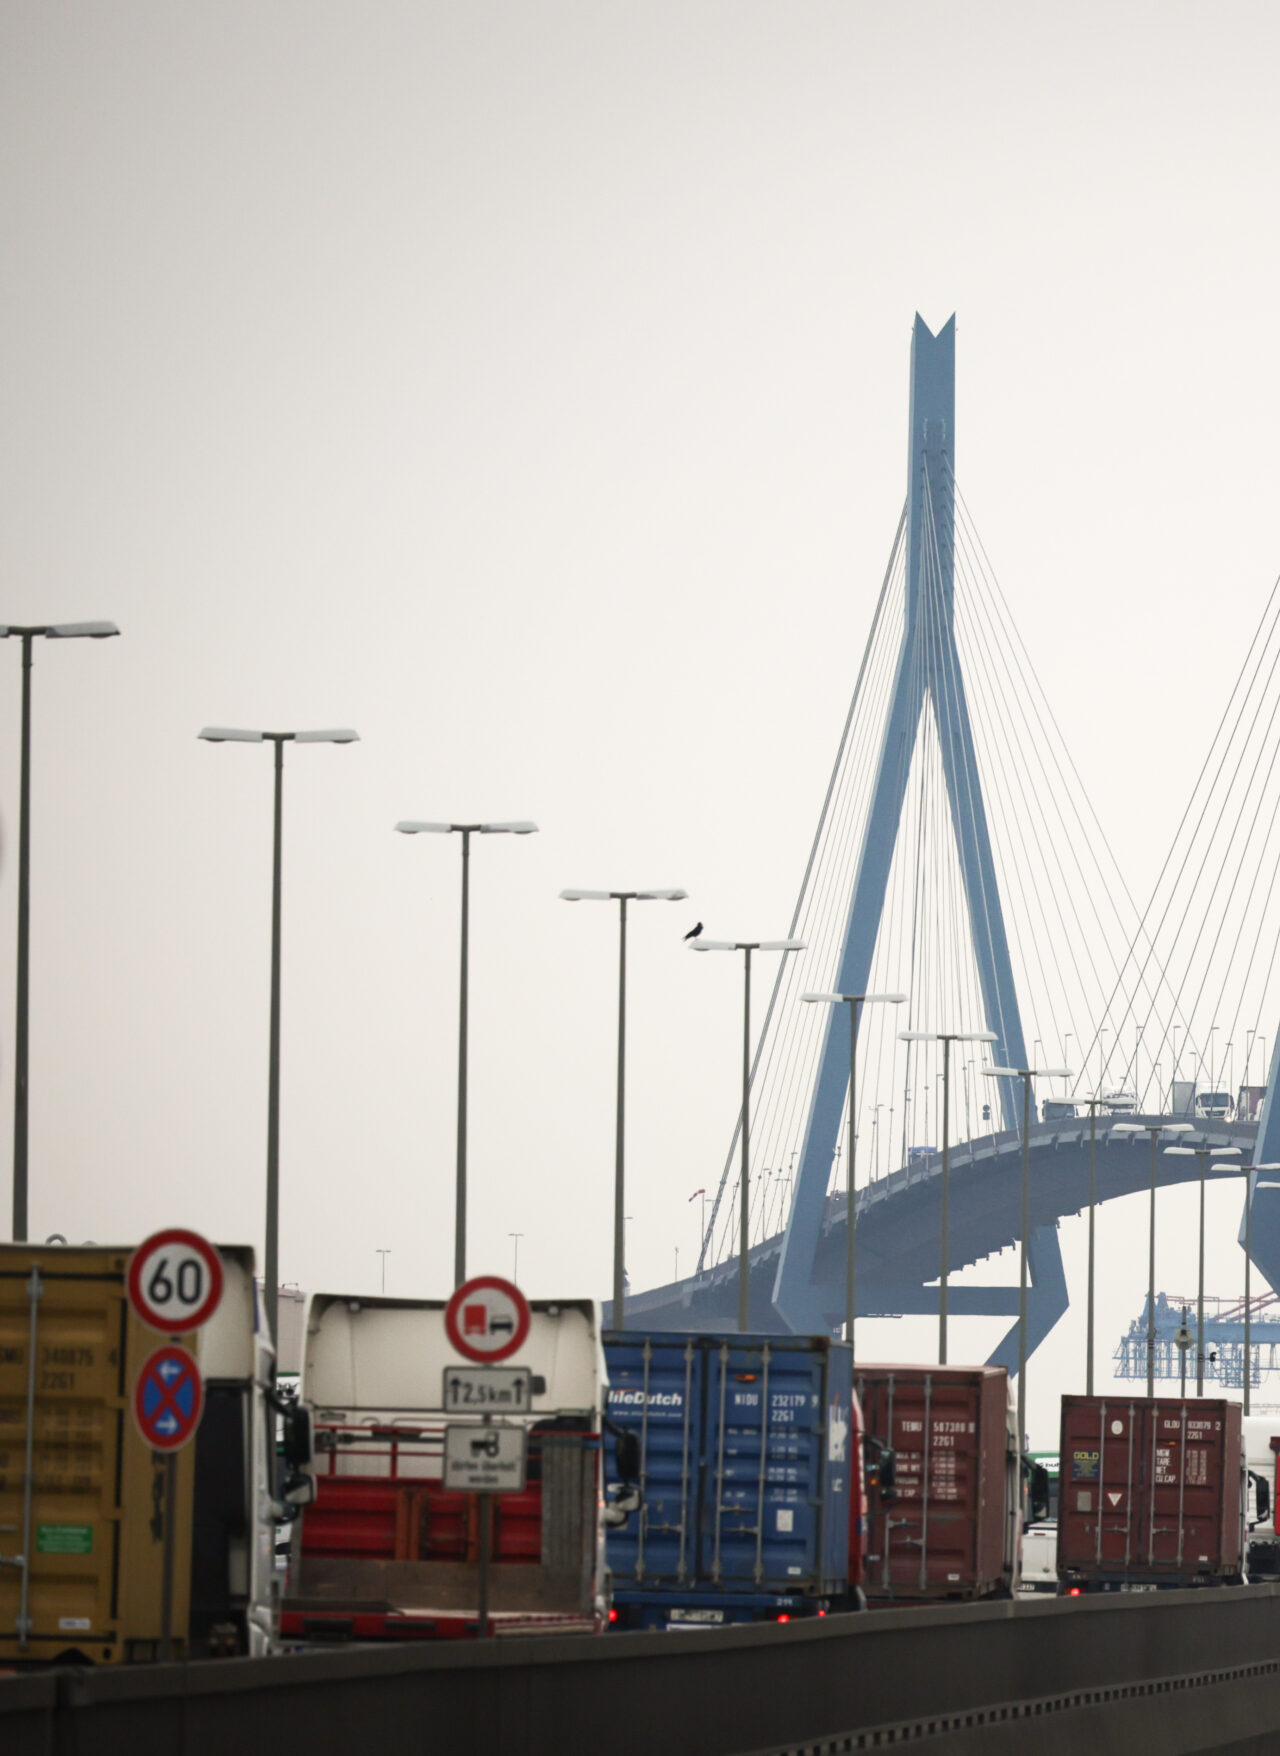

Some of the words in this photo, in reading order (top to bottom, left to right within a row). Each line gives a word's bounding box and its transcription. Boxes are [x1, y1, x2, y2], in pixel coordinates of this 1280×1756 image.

[148, 1257, 202, 1305] 60
[734, 1394, 759, 1405] NIDU
[771, 1395, 806, 1407] 232179
[811, 1395, 819, 1408] 9
[1073, 1451, 1099, 1460] GOLD
